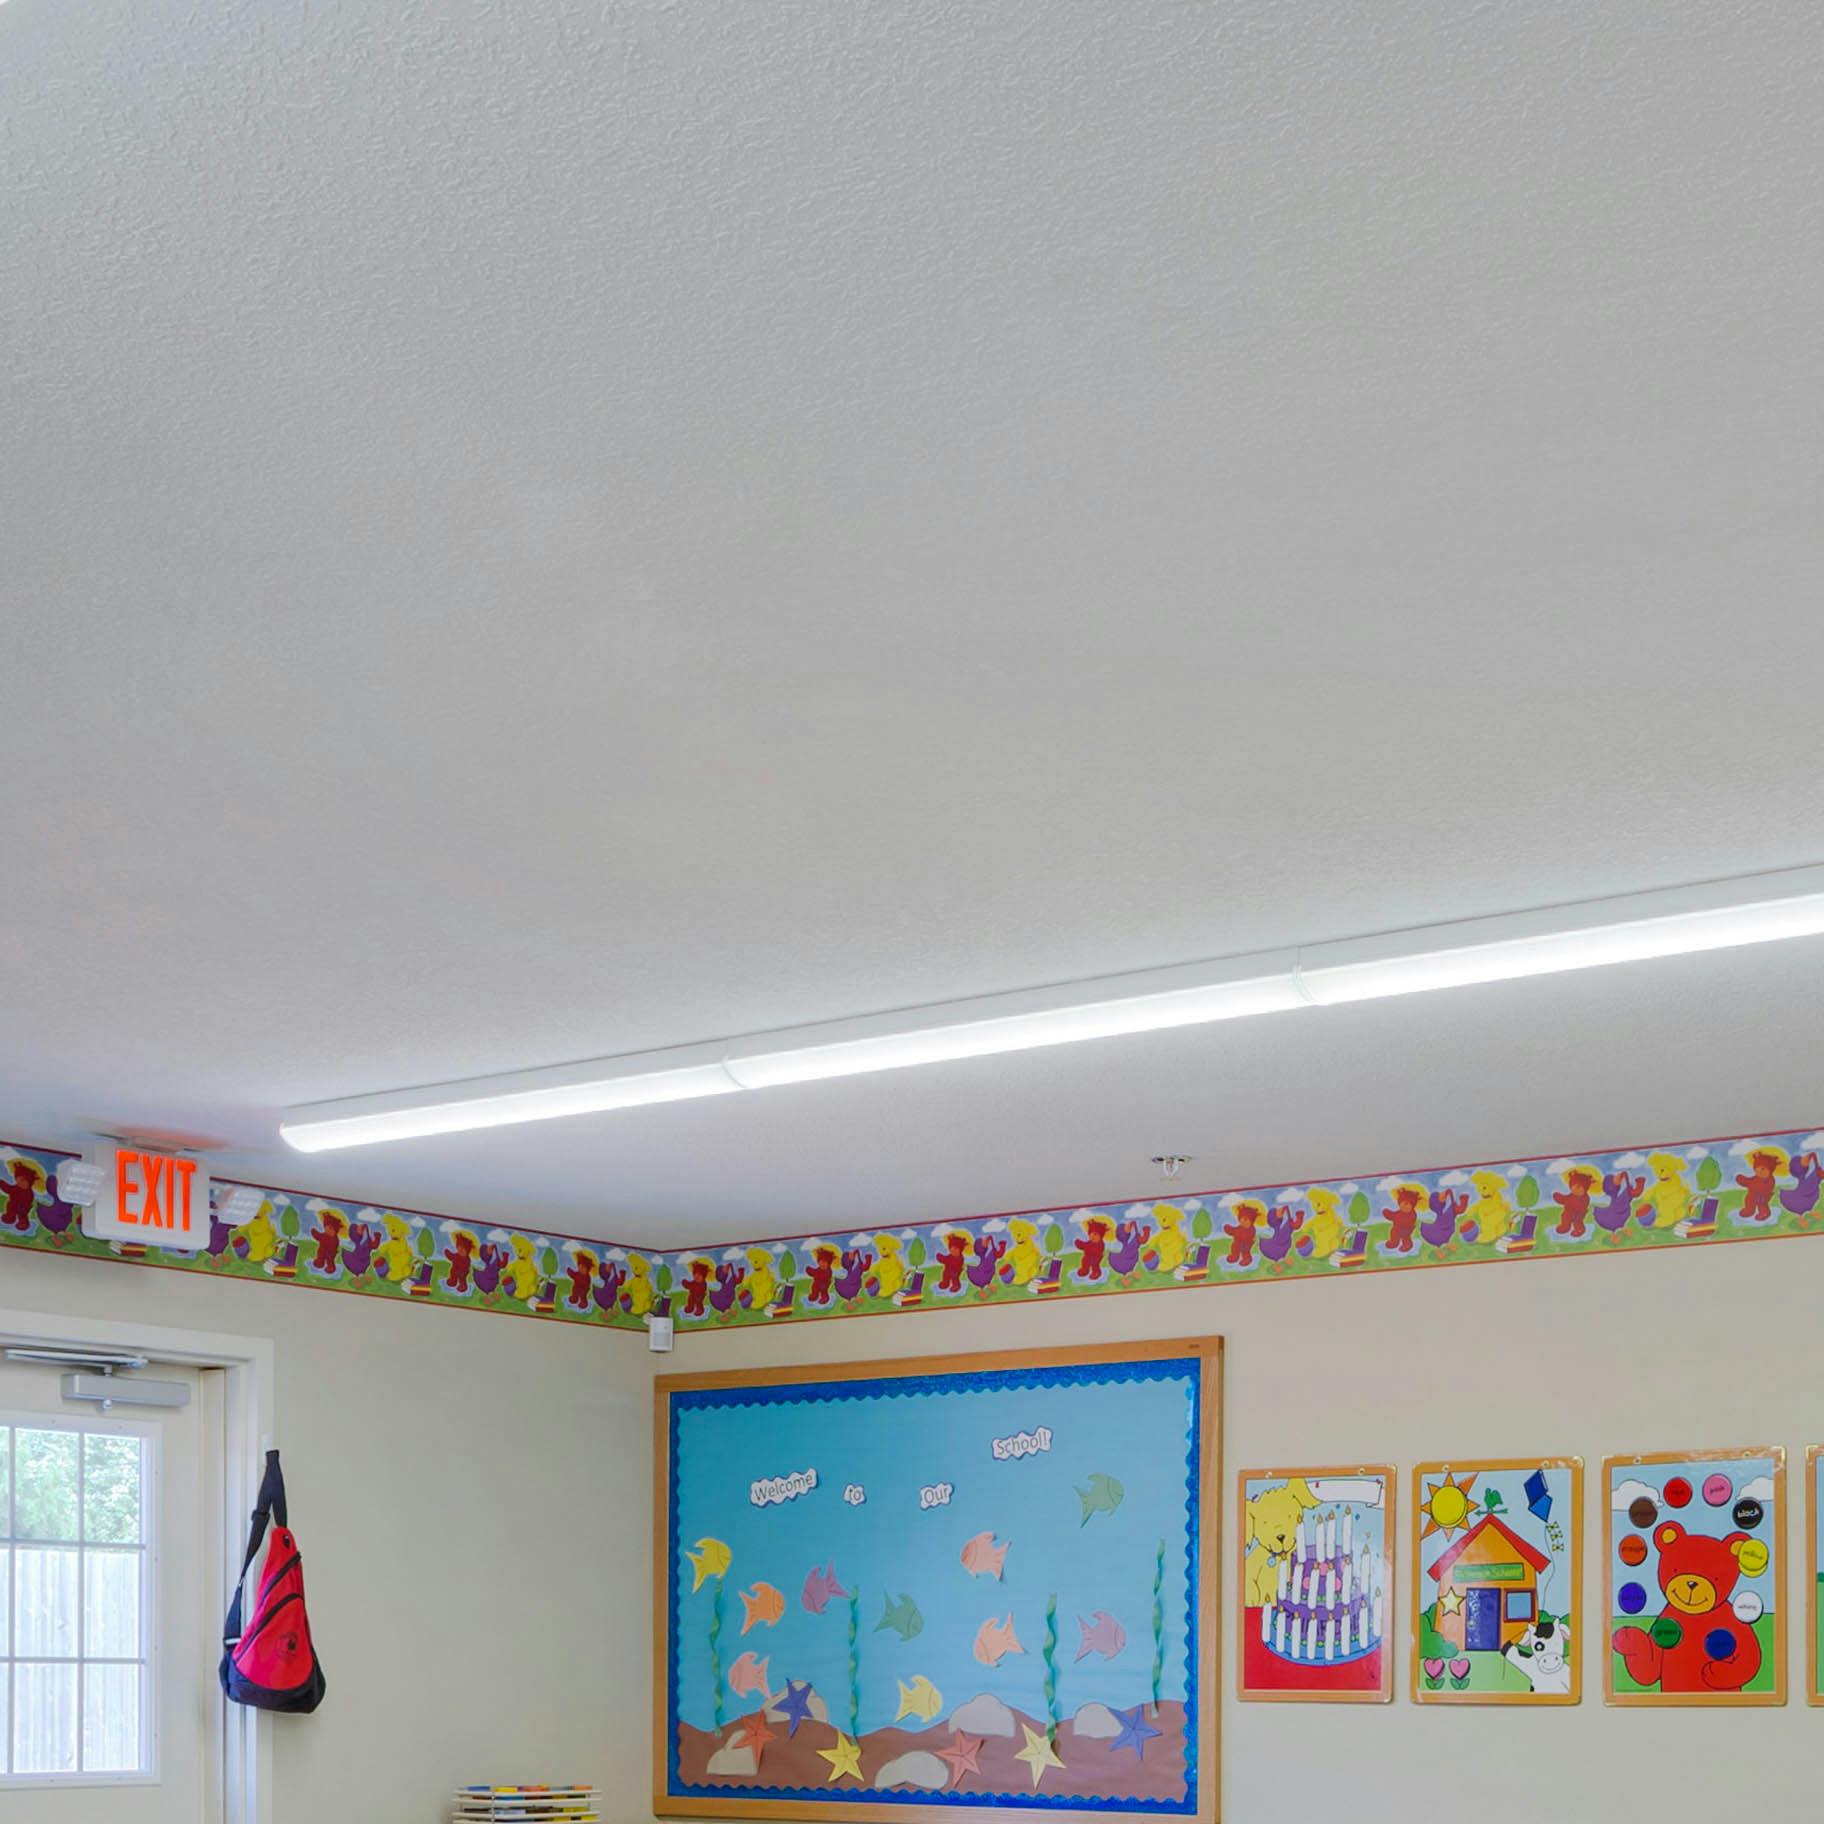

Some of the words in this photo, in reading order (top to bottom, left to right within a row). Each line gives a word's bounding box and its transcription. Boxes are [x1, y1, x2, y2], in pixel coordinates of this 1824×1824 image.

[115, 1148, 198, 1232] EXIT
[753, 1471, 815, 1504] Welcome
[848, 1486, 863, 1502] to
[922, 1485, 951, 1505] Our
[994, 1428, 1050, 1457] School!
[1737, 1508, 1760, 1519] black
